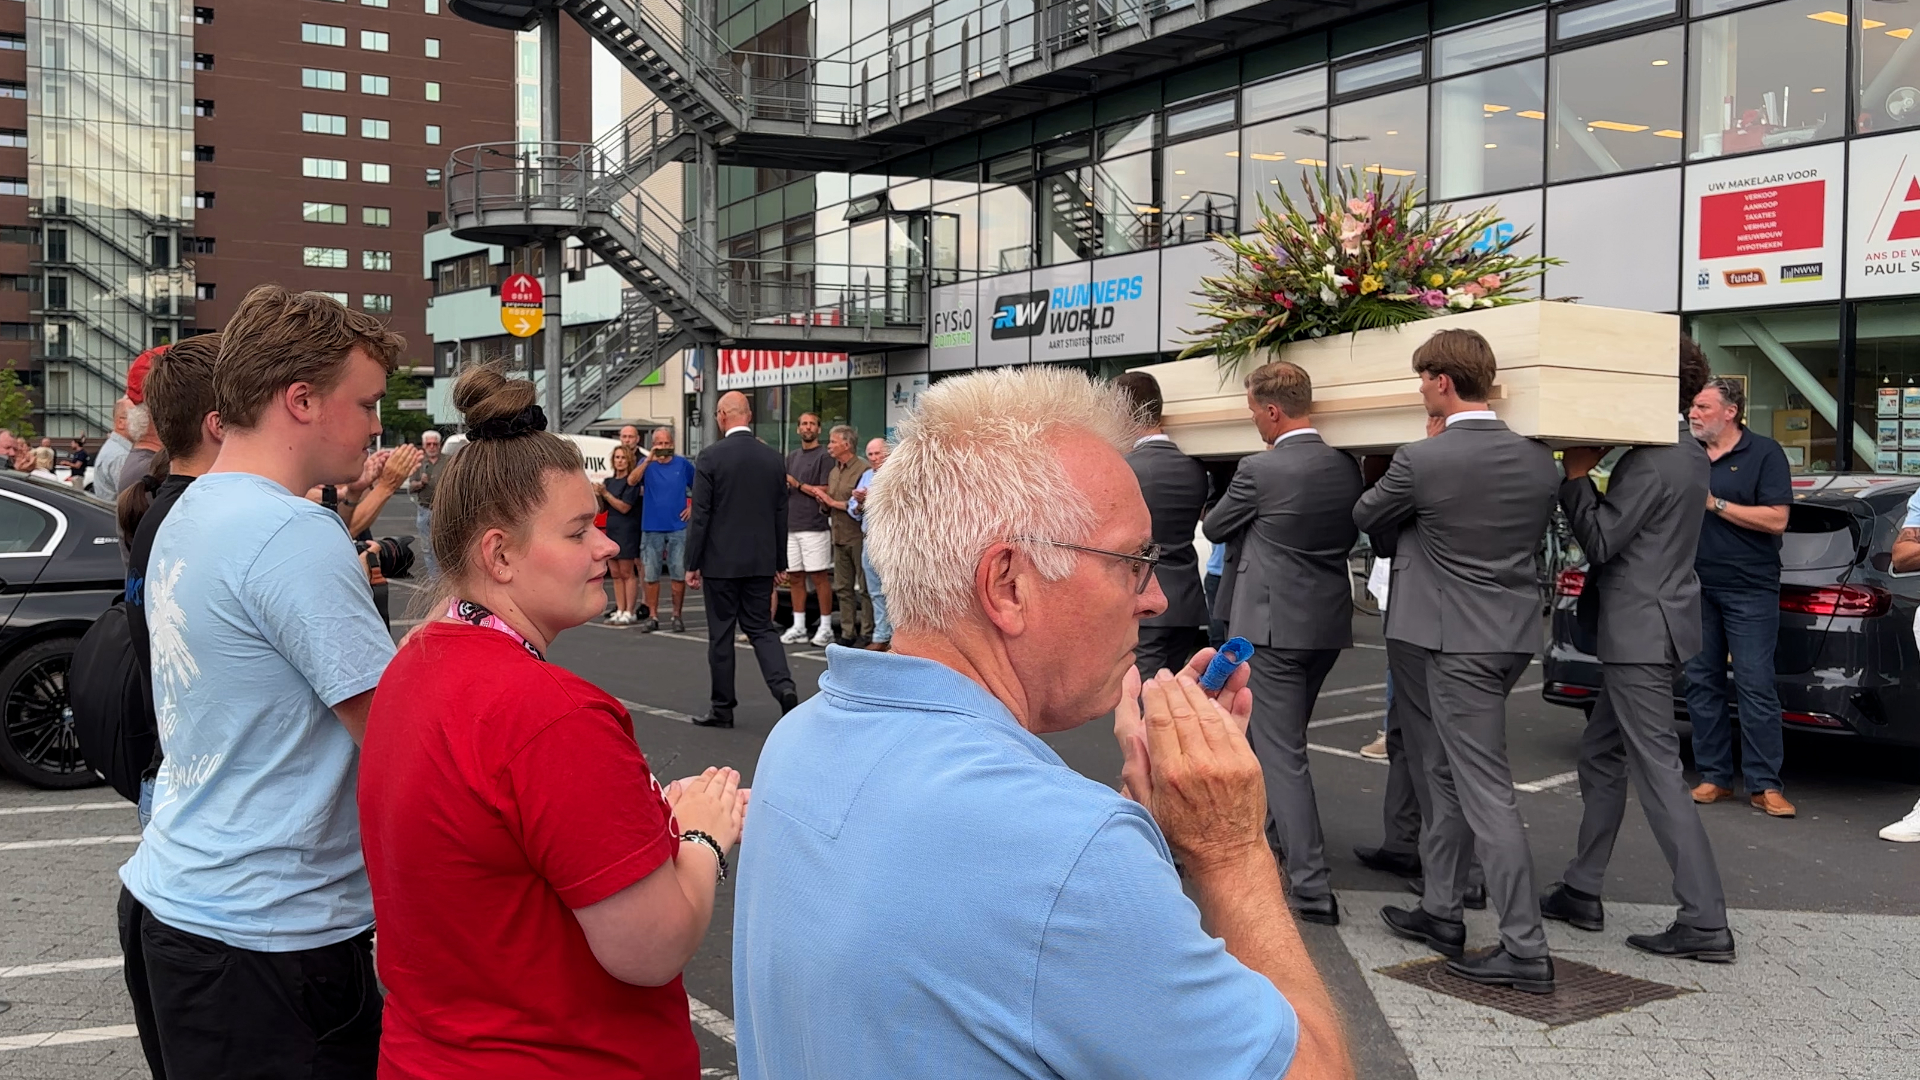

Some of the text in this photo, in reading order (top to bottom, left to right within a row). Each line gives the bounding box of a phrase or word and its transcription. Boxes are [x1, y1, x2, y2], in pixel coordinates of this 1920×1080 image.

[1708, 169, 1818, 192] UW MAKELAAR VOOR
[1744, 191, 1778, 201] VERKOOP
[1743, 201, 1778, 212] AANKOOP
[1744, 211, 1777, 221] TAXATIES
[1743, 221, 1777, 231] VERHUUR
[1737, 230, 1783, 242] NIEUWBOUW
[1737, 240, 1783, 252] HYPOTHEKEN
[1865, 252, 1888, 261] ANS
[1892, 250, 1906, 259] DE
[1864, 263, 1906, 277] PAUL
[1730, 272, 1760, 284] funda
[1051, 275, 1143, 309] RUNNERS
[1050, 306, 1115, 335] WORLD
[1049, 333, 1125, 350] AART STIGTER UTRECHT
[585, 457, 606, 472] IJK
